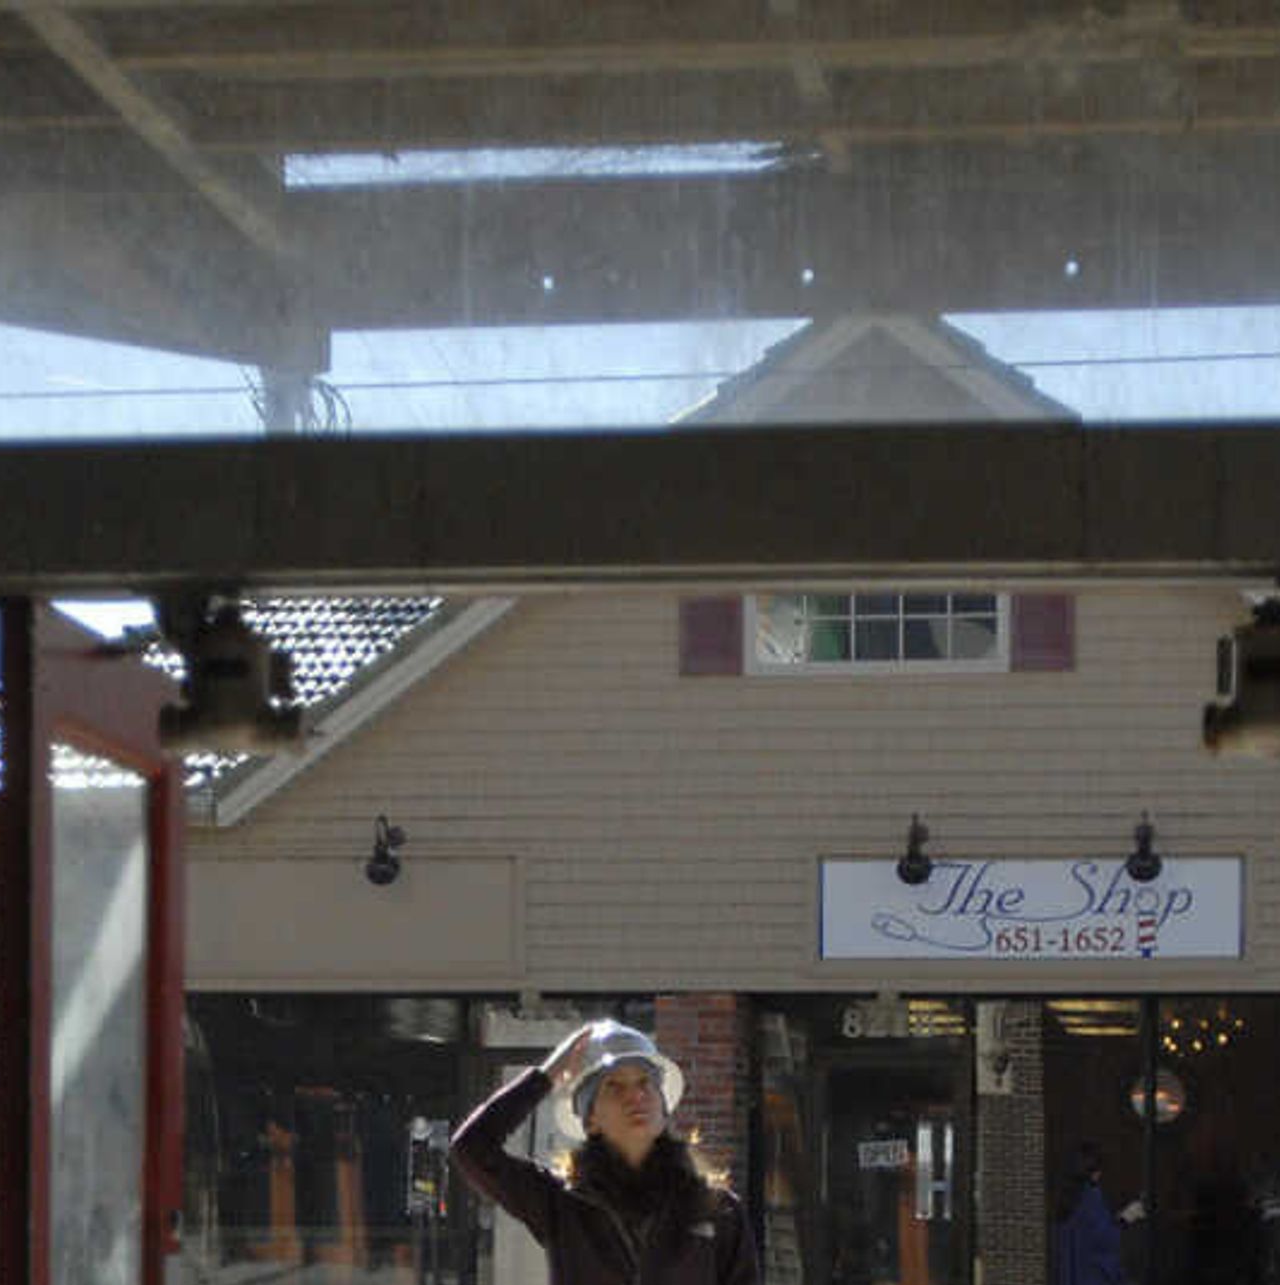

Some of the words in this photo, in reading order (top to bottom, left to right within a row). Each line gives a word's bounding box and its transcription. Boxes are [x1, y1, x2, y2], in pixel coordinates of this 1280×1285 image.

[918, 862, 1026, 917] The
[1071, 861, 1193, 927] Shop
[995, 928, 1127, 954] 651-1652
